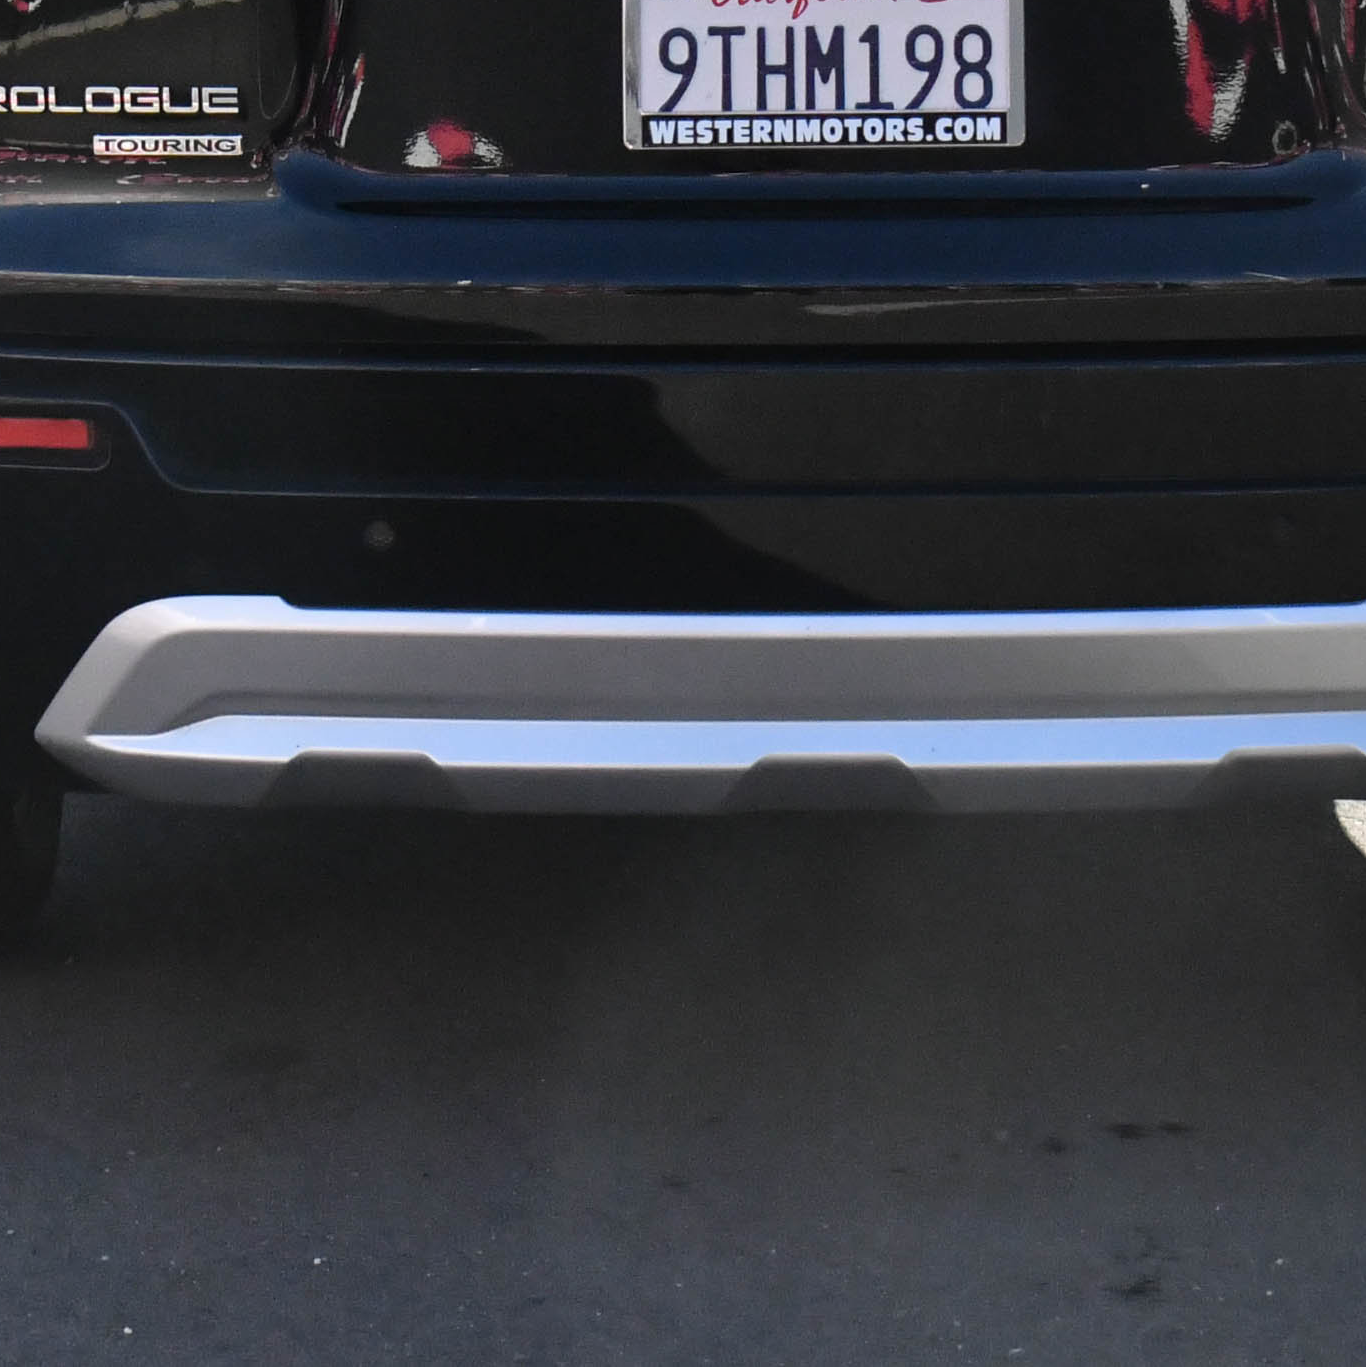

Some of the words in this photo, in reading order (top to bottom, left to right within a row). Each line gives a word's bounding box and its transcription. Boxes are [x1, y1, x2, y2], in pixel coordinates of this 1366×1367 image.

[658, 24, 994, 112] 9THM198
[649, 117, 1002, 144] WESTERNMOTORS.COM
[98, 138, 237, 154] TOURING
